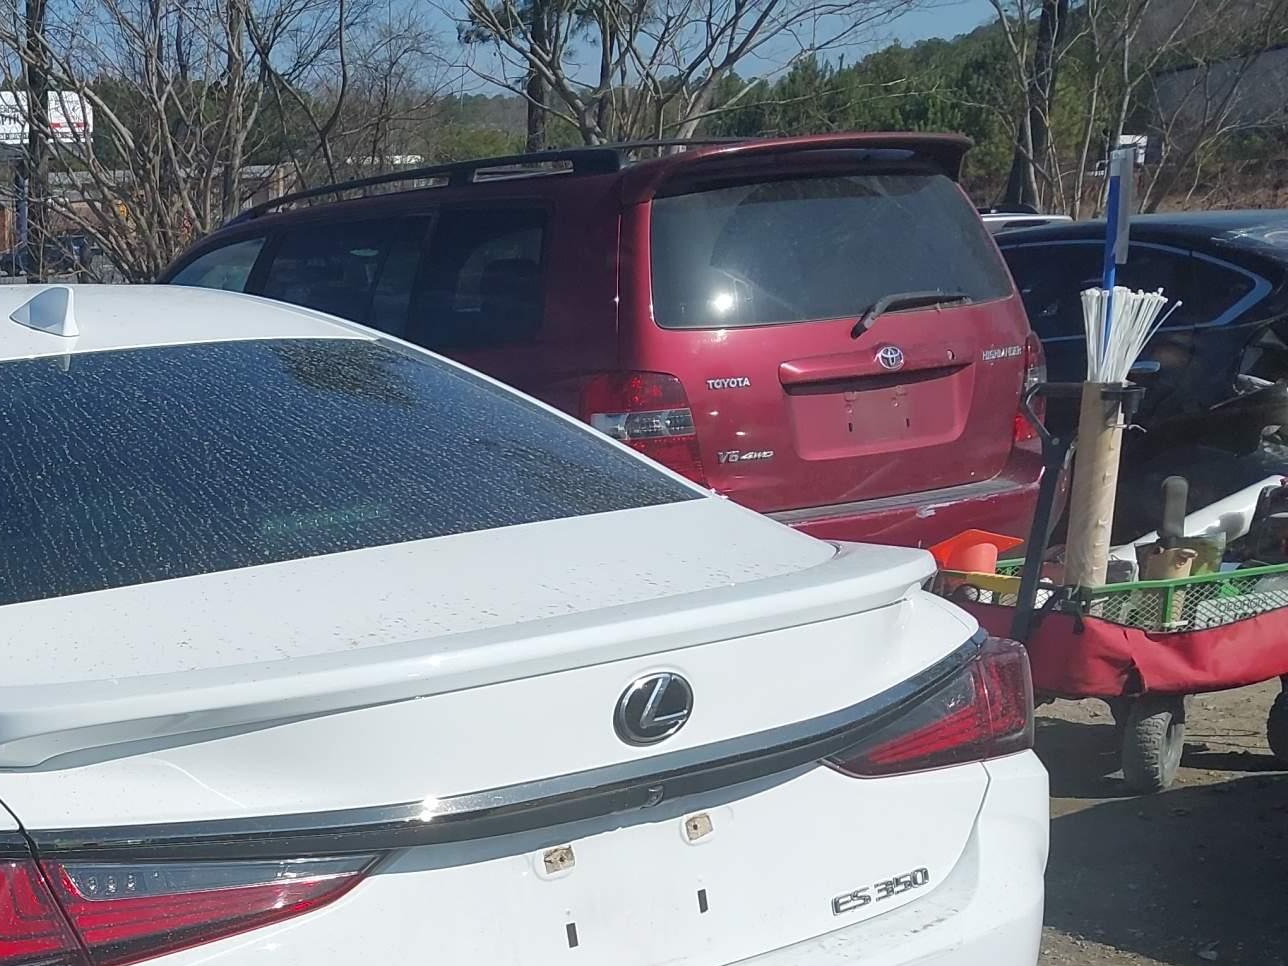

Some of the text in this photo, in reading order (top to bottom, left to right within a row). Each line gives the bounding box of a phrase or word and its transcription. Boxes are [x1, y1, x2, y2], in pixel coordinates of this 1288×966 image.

[706, 377, 751, 390] TOYOTA
[717, 450, 774, 464] V6 4WD
[831, 866, 930, 916] ES 350
